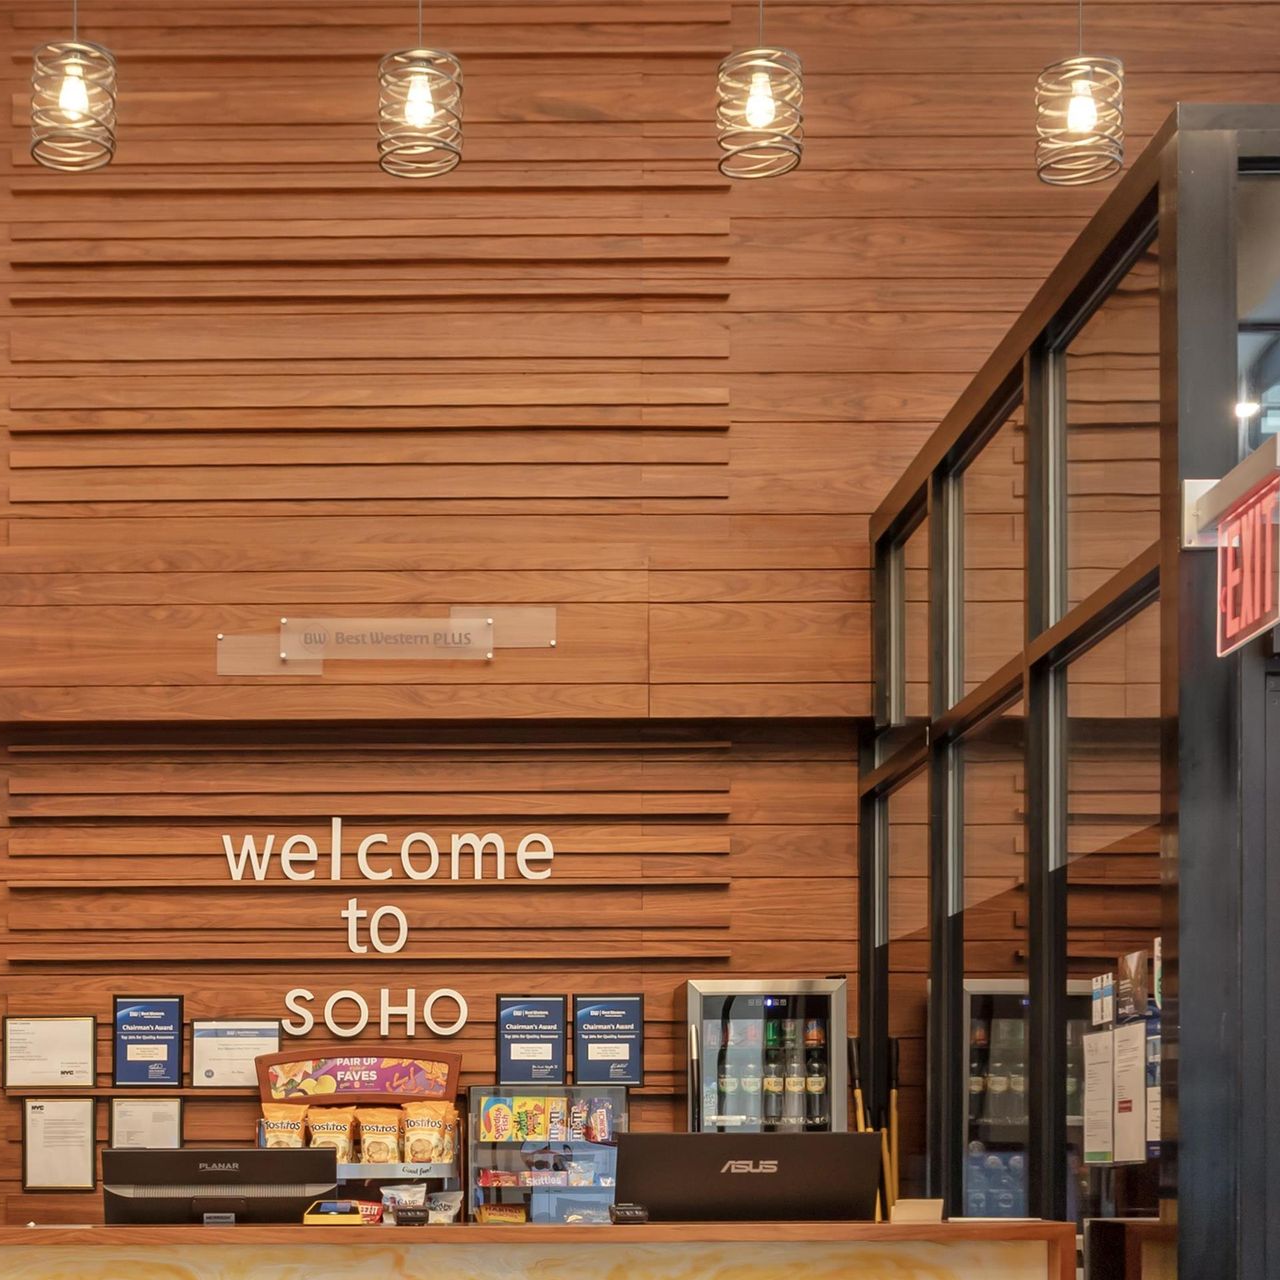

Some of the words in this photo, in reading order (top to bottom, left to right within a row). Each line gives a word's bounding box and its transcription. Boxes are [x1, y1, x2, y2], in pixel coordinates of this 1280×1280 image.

[1226, 491, 1277, 638] EXIT
[303, 632, 326, 645] BW
[335, 632, 367, 645] Best
[370, 632, 429, 645] Western
[432, 632, 472, 645] PLUS
[222, 817, 554, 880] welcome
[340, 897, 408, 953] to
[281, 988, 468, 1037] SOHO
[337, 1058, 360, 1066] PAIR
[363, 1058, 377, 1066] UP
[337, 1071, 377, 1081] FAVES
[494, 1107, 503, 1140] Swedish
[720, 1160, 778, 1173] ASUS
[526, 1176, 561, 1186] Skittles
